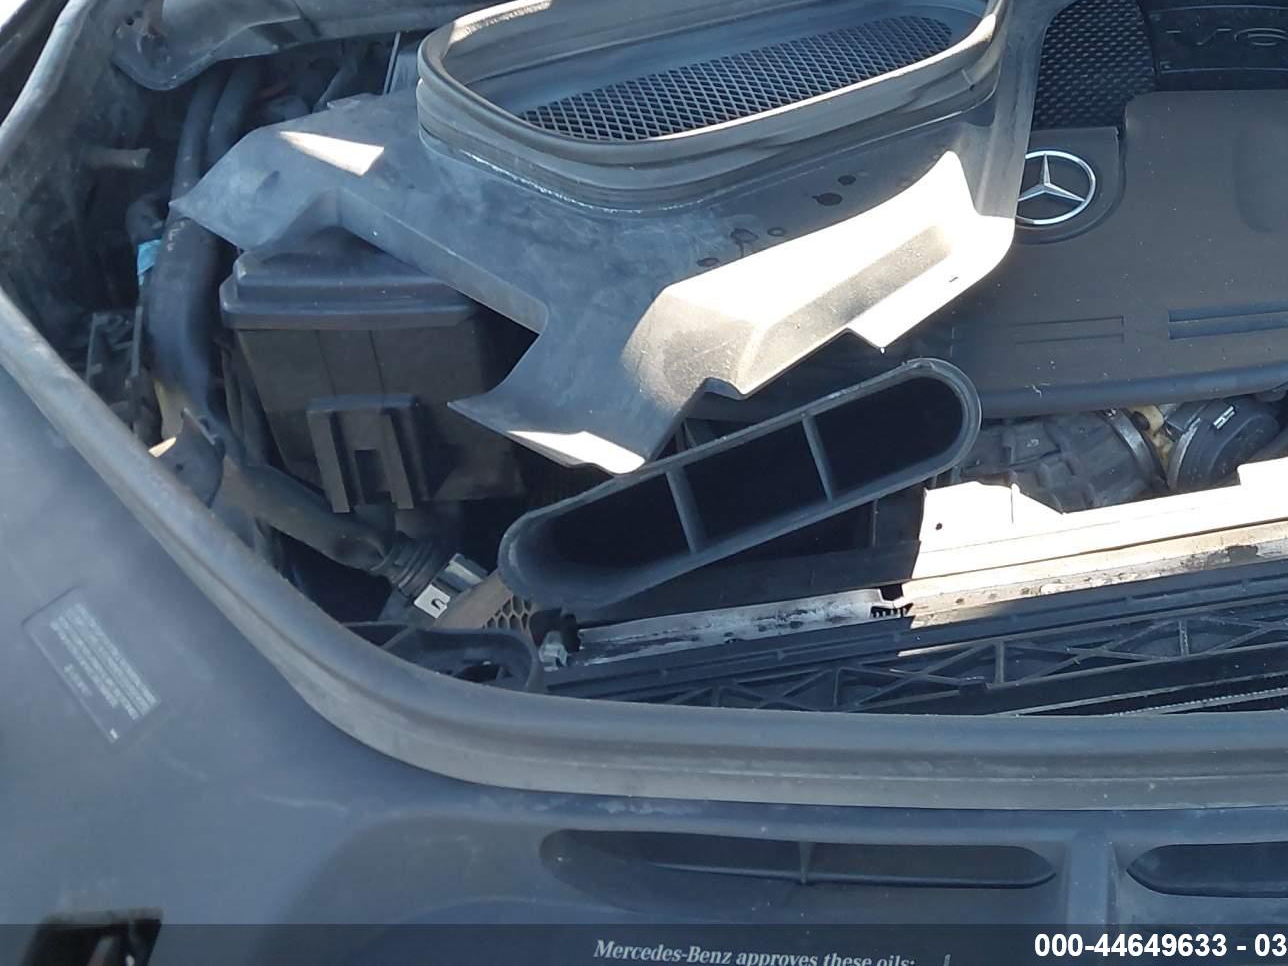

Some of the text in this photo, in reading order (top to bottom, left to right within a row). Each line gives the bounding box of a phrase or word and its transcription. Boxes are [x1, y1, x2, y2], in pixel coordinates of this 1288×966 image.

[593, 939, 733, 965] Mercedes-Benz
[735, 951, 818, 966] approves
[822, 952, 873, 966] these
